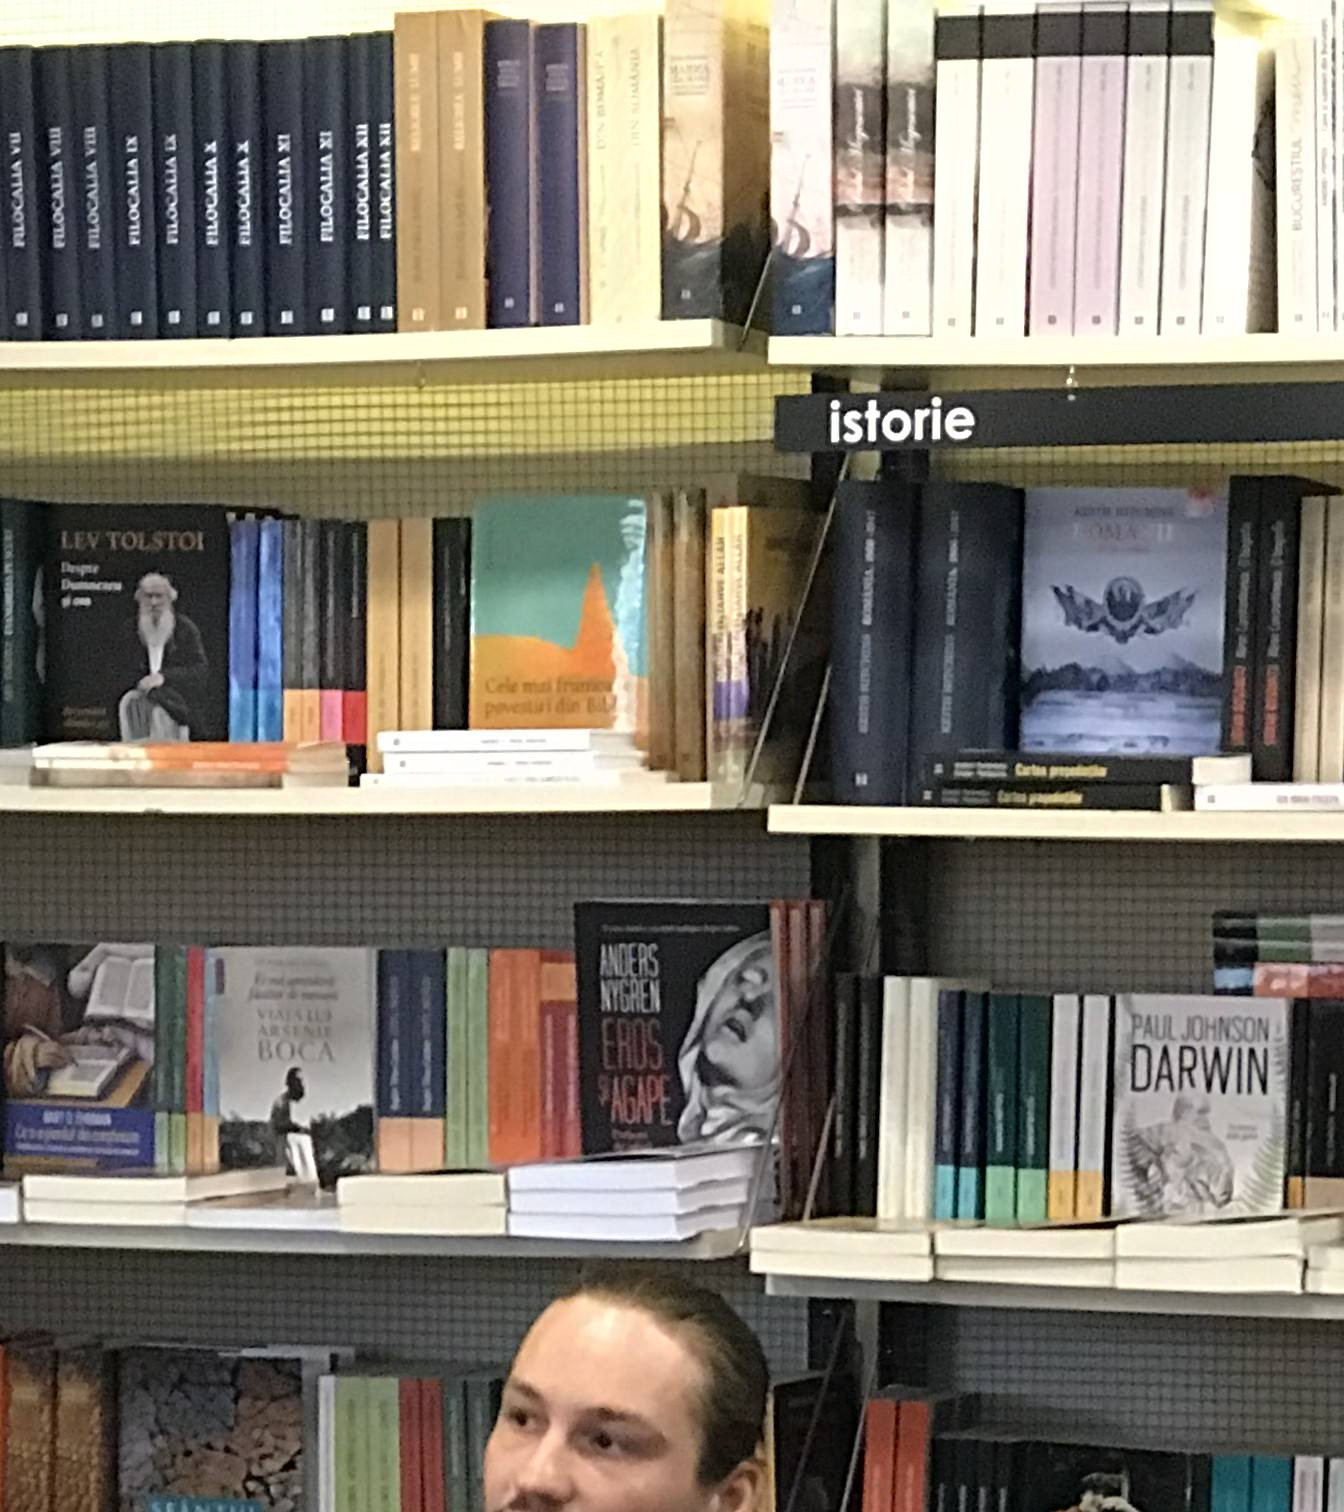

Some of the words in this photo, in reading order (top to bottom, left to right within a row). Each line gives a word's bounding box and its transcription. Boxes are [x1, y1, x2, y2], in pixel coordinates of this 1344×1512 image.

[11, 160, 25, 247] FILOCALIA
[51, 161, 65, 248] FILOCALIA
[87, 161, 100, 248] FILOCALIA
[128, 159, 140, 245] FILOCALIA
[166, 157, 178, 244] FILOCALIA
[206, 157, 218, 245] FILOCALIA
[239, 157, 250, 245] FILOCALIA
[279, 157, 292, 244] FILOCALIA
[320, 154, 333, 241] FILOCALIA
[357, 151, 369, 240] FILOCALIA
[380, 151, 391, 239] FILOCALIA
[829, 398, 975, 446] istorie
[61, 530, 101, 549] LEV
[106, 531, 205, 551] TOLSTOI
[485, 678, 518, 694] Cele
[522, 679, 552, 694] mai
[556, 695, 581, 714] din
[600, 943, 658, 977] ANDERS
[308, 1008, 332, 1021] LUI
[601, 978, 660, 1013] NYGREN
[258, 1040, 336, 1062] BOCA
[602, 1018, 663, 1070] EROS
[1131, 1013, 1174, 1042] PAUL
[1181, 1015, 1270, 1042] JOHNSON
[1130, 1044, 1268, 1094] DARWIN
[611, 1074, 673, 1126] AGAPE
